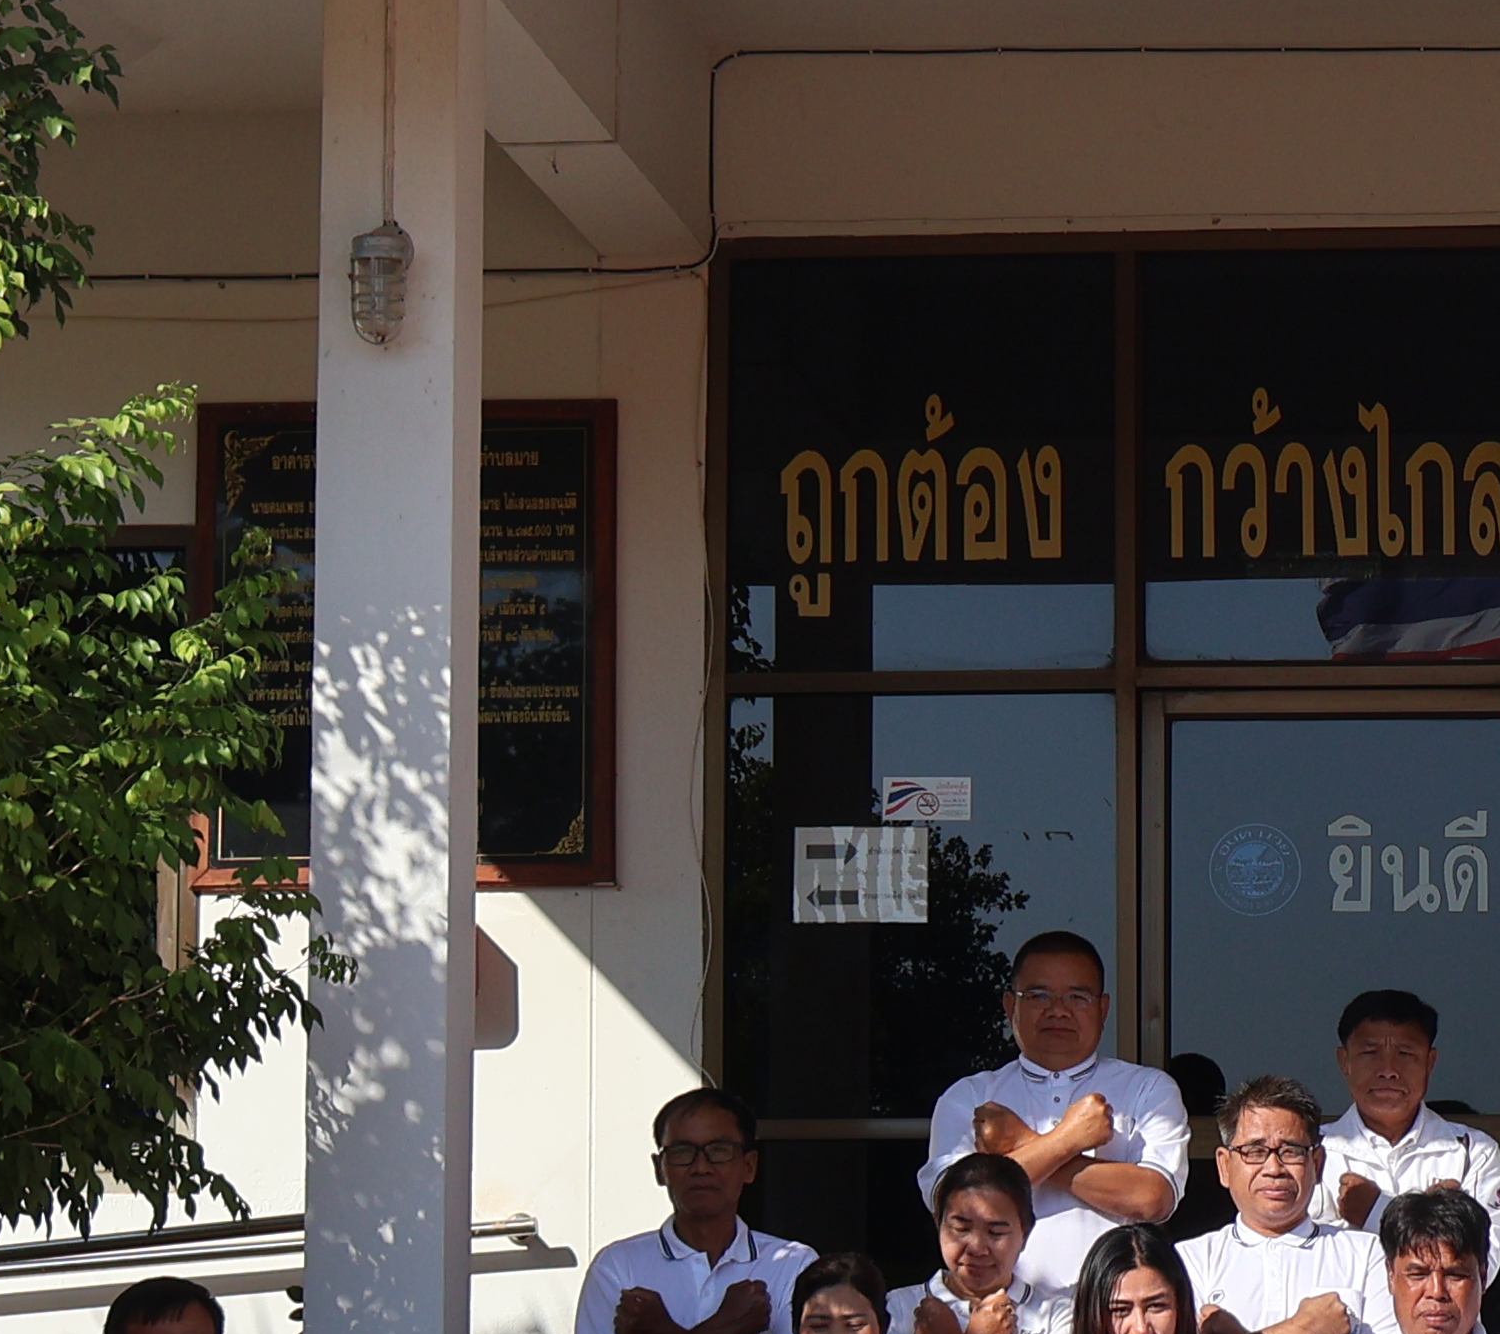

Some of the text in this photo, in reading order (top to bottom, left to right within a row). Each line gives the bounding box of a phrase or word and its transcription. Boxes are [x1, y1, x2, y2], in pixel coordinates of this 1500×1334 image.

[780, 393, 1064, 618] ถูกต้อง
[1327, 810, 1489, 913] ยินดี
